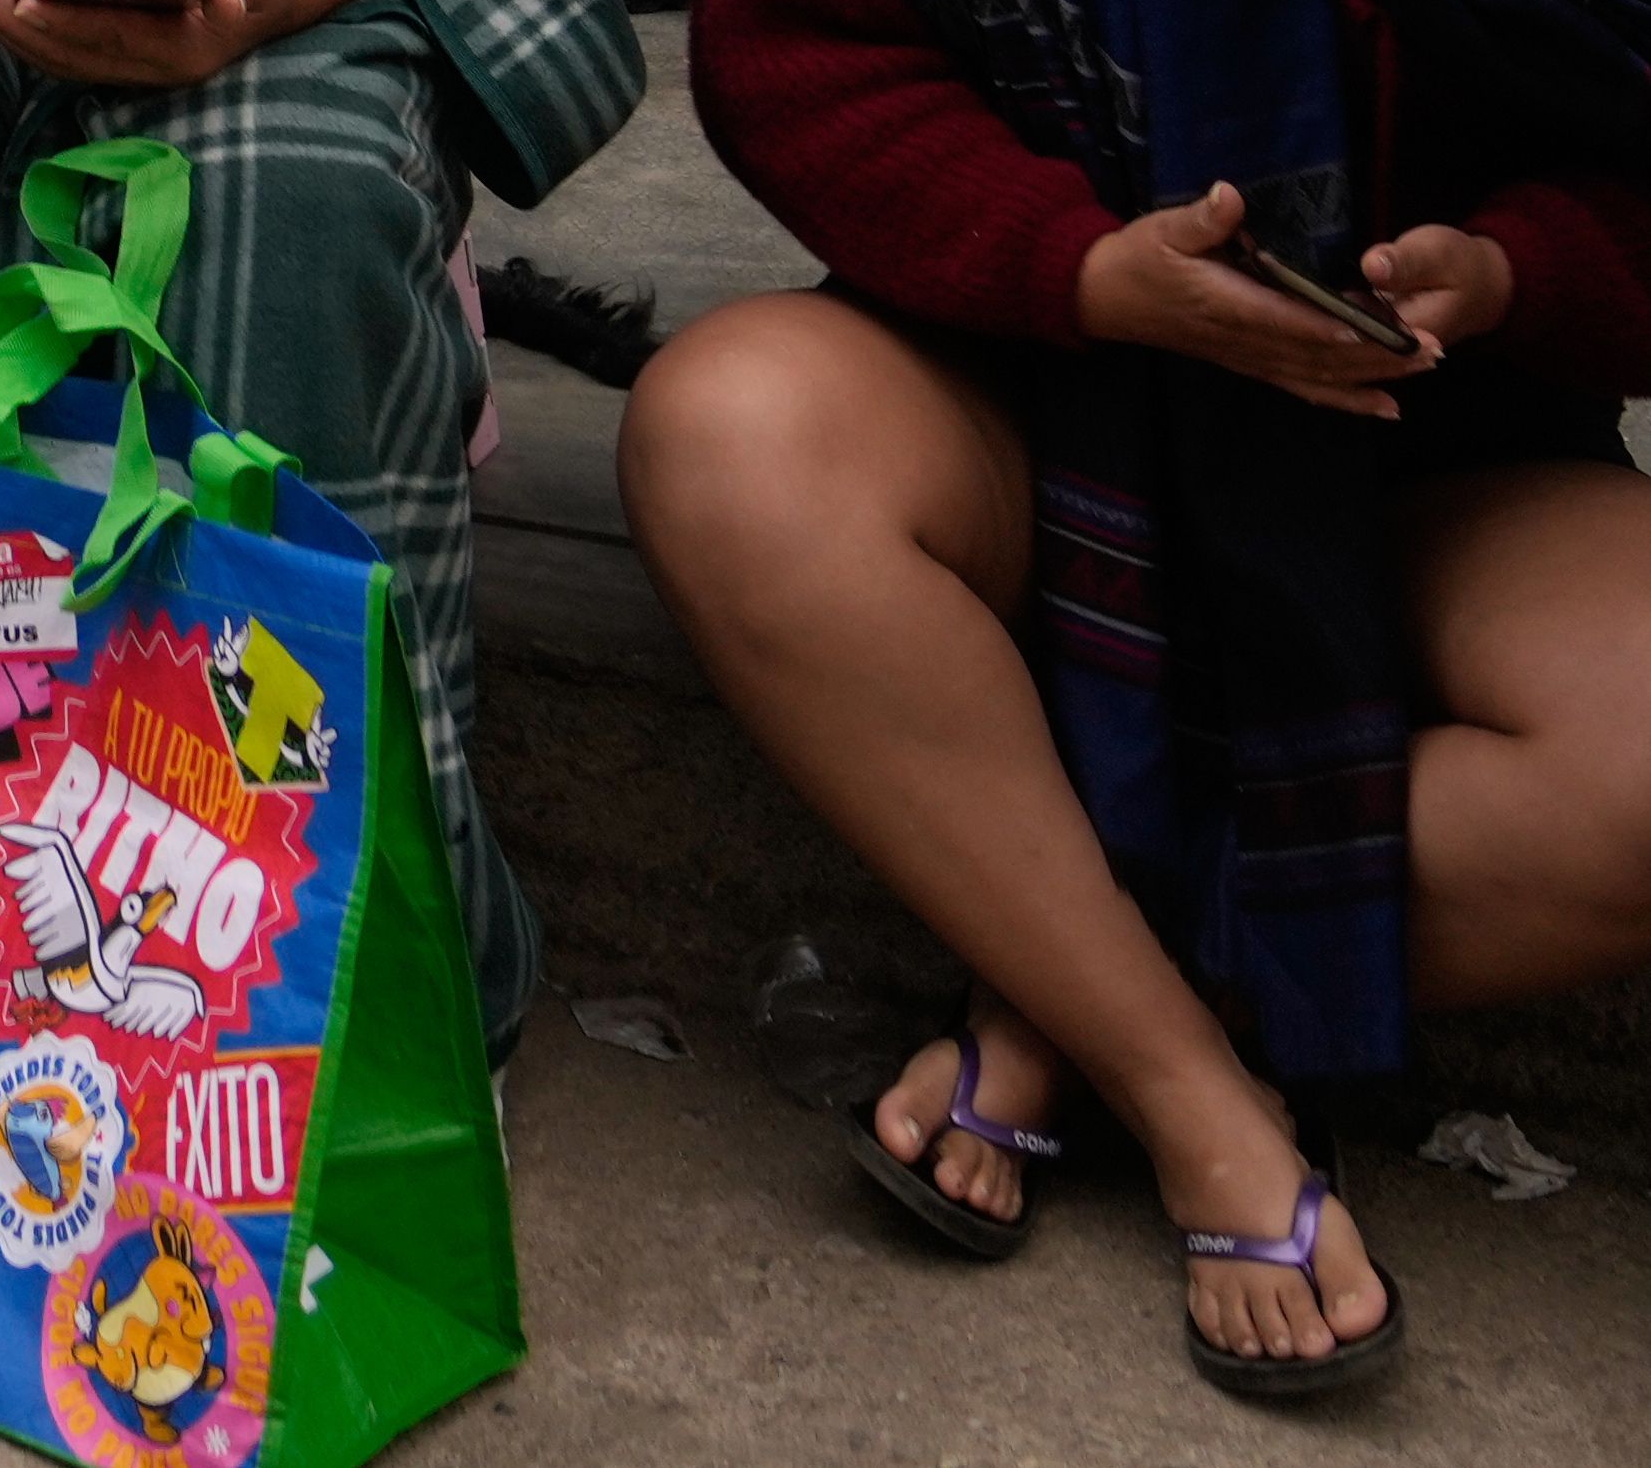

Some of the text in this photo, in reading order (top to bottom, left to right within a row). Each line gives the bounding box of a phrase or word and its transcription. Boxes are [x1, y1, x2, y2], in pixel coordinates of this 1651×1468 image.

[104, 686, 123, 766] A
[127, 698, 165, 786] TU
[31, 741, 265, 972] RITMO
[70, 1063, 106, 1119] TODO
[86, 1152, 103, 1187] TU
[32, 1190, 96, 1246] PUEDES
